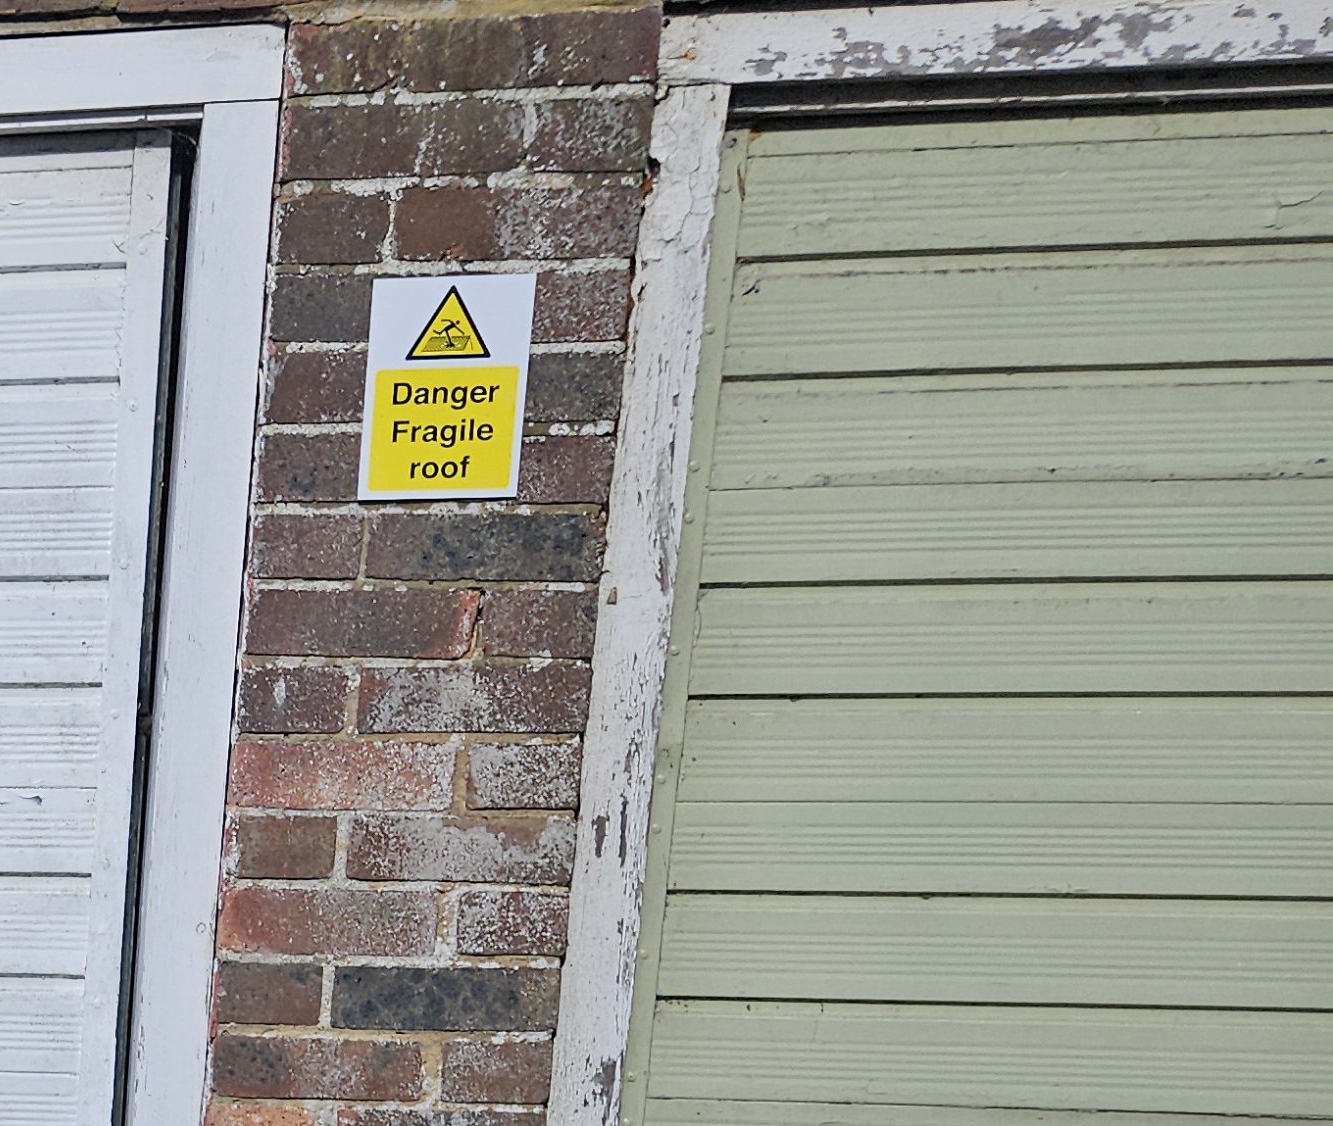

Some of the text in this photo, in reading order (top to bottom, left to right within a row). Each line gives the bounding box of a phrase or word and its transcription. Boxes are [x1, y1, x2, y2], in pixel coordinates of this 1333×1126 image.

[392, 382, 500, 410] Danger
[391, 418, 494, 448] Fragile
[409, 455, 471, 479] roof
